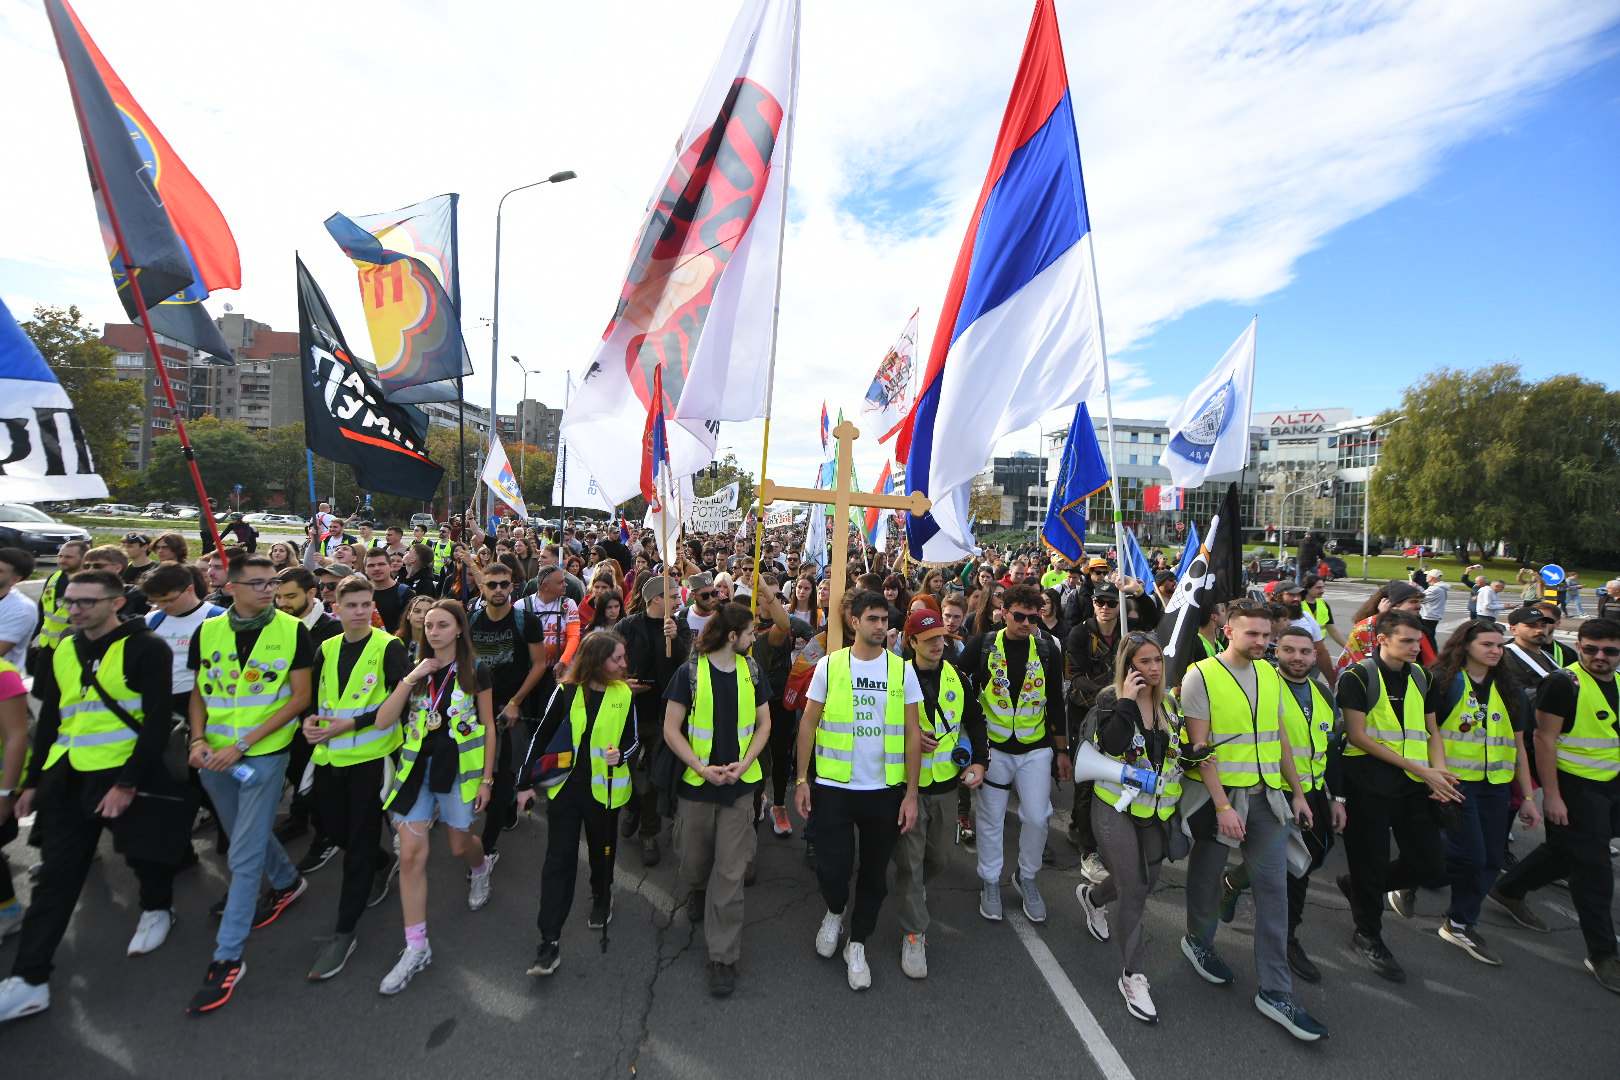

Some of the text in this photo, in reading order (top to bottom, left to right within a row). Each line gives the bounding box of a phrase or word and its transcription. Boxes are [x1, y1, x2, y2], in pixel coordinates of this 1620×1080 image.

[1272, 413, 1325, 425] ALTA
[1270, 424, 1325, 436] BANKA
[692, 505, 729, 518] РОТИВ
[856, 677, 888, 689] Maru
[852, 694, 876, 707] 360
[855, 711, 874, 721] na
[852, 726, 882, 737] 800
